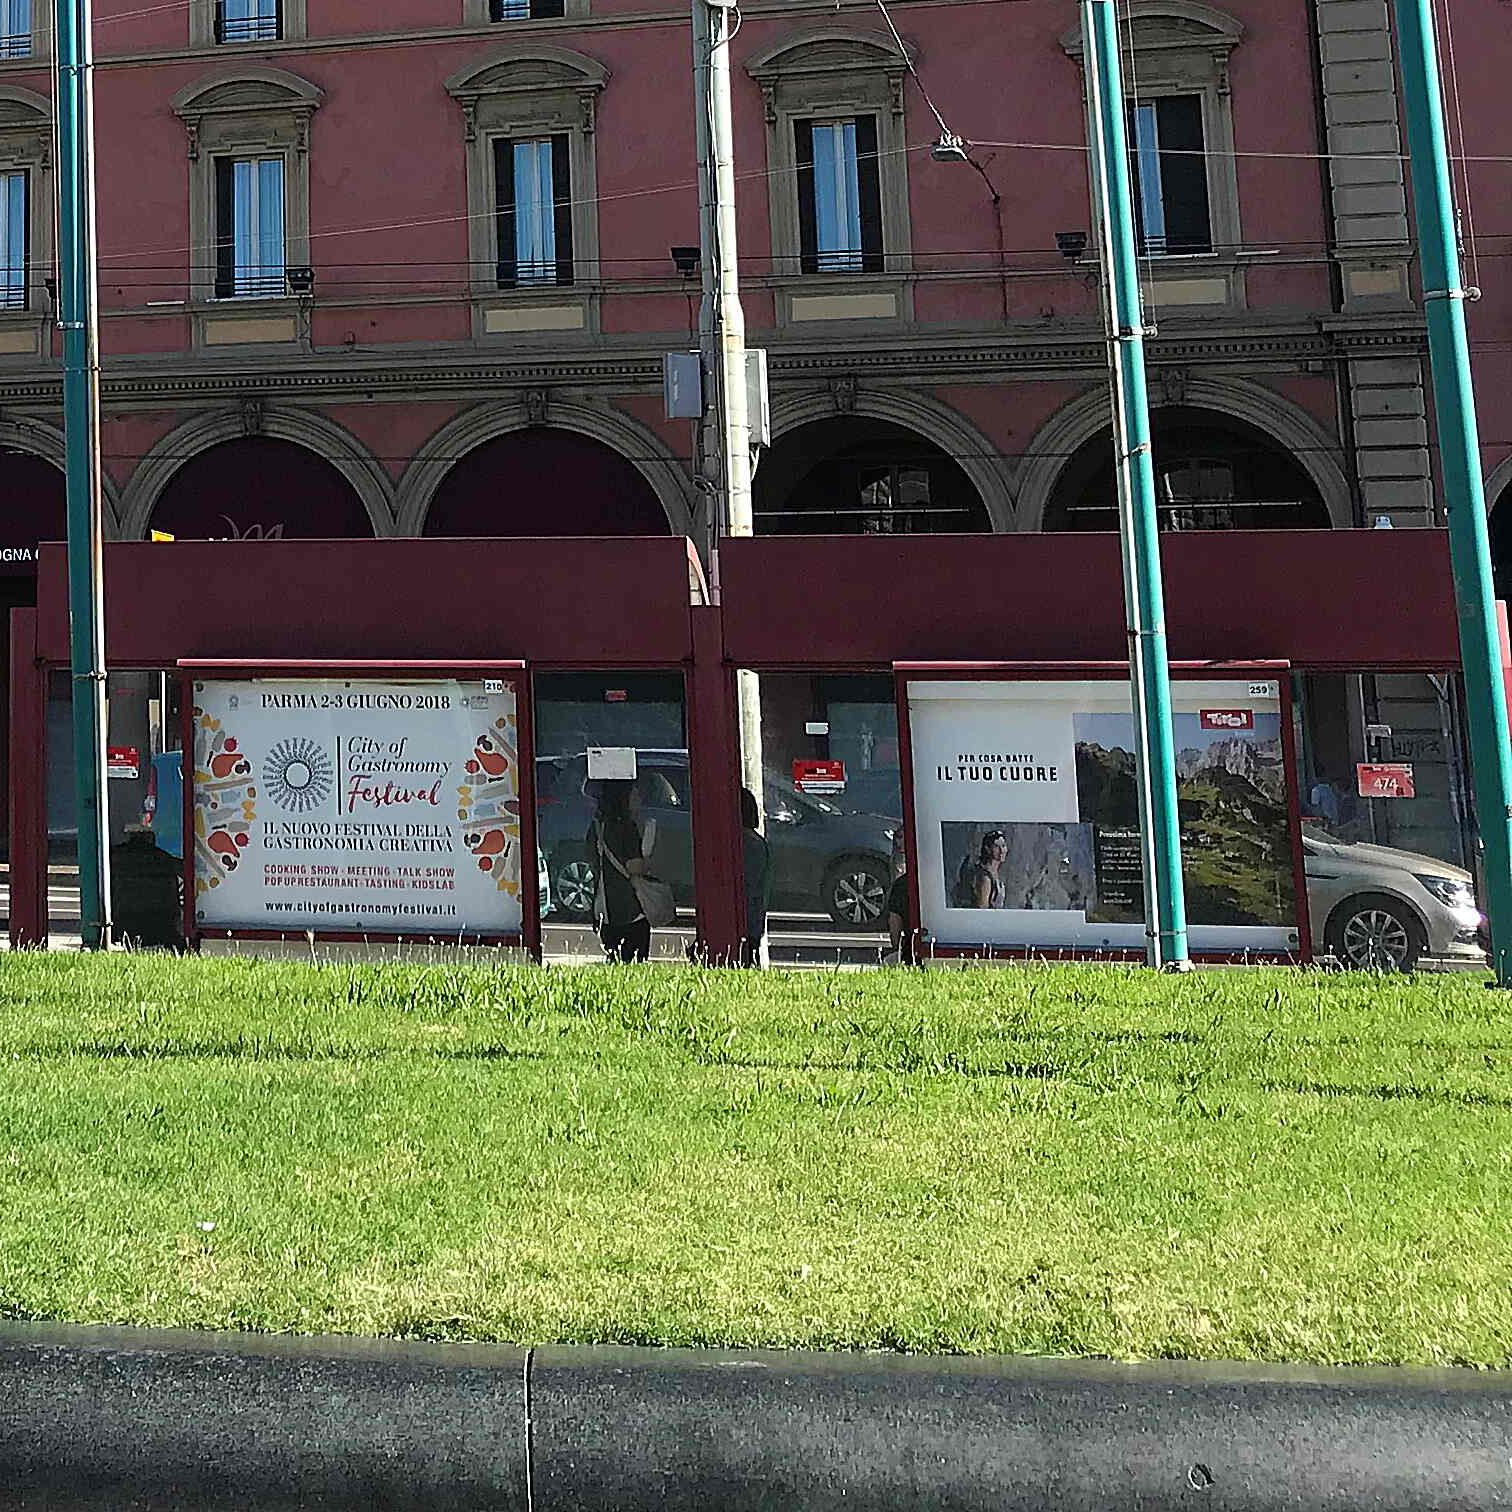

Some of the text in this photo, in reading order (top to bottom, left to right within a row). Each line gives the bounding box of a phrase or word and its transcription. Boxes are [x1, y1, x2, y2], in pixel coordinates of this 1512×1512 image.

[1249, 686, 1268, 694] 259
[261, 694, 451, 709] PARMA 2-3 GIUGNO 2018
[347, 737, 408, 759] City of
[978, 754, 1002, 763] COSA
[347, 755, 452, 778] Gastronomy
[937, 766, 1058, 782] IL TUO CUORE
[347, 775, 442, 813] Festival
[263, 821, 453, 838] IL NUOVO FESTIVAL DELLA
[263, 837, 453, 852] GASTRONOMIA CREATIVA
[264, 864, 456, 878] COOKING SHOW MEETING TALK SHOW
[363, 878, 406, 890] TASTING
[264, 900, 457, 916] www.cityofgastronomyfestival.it
